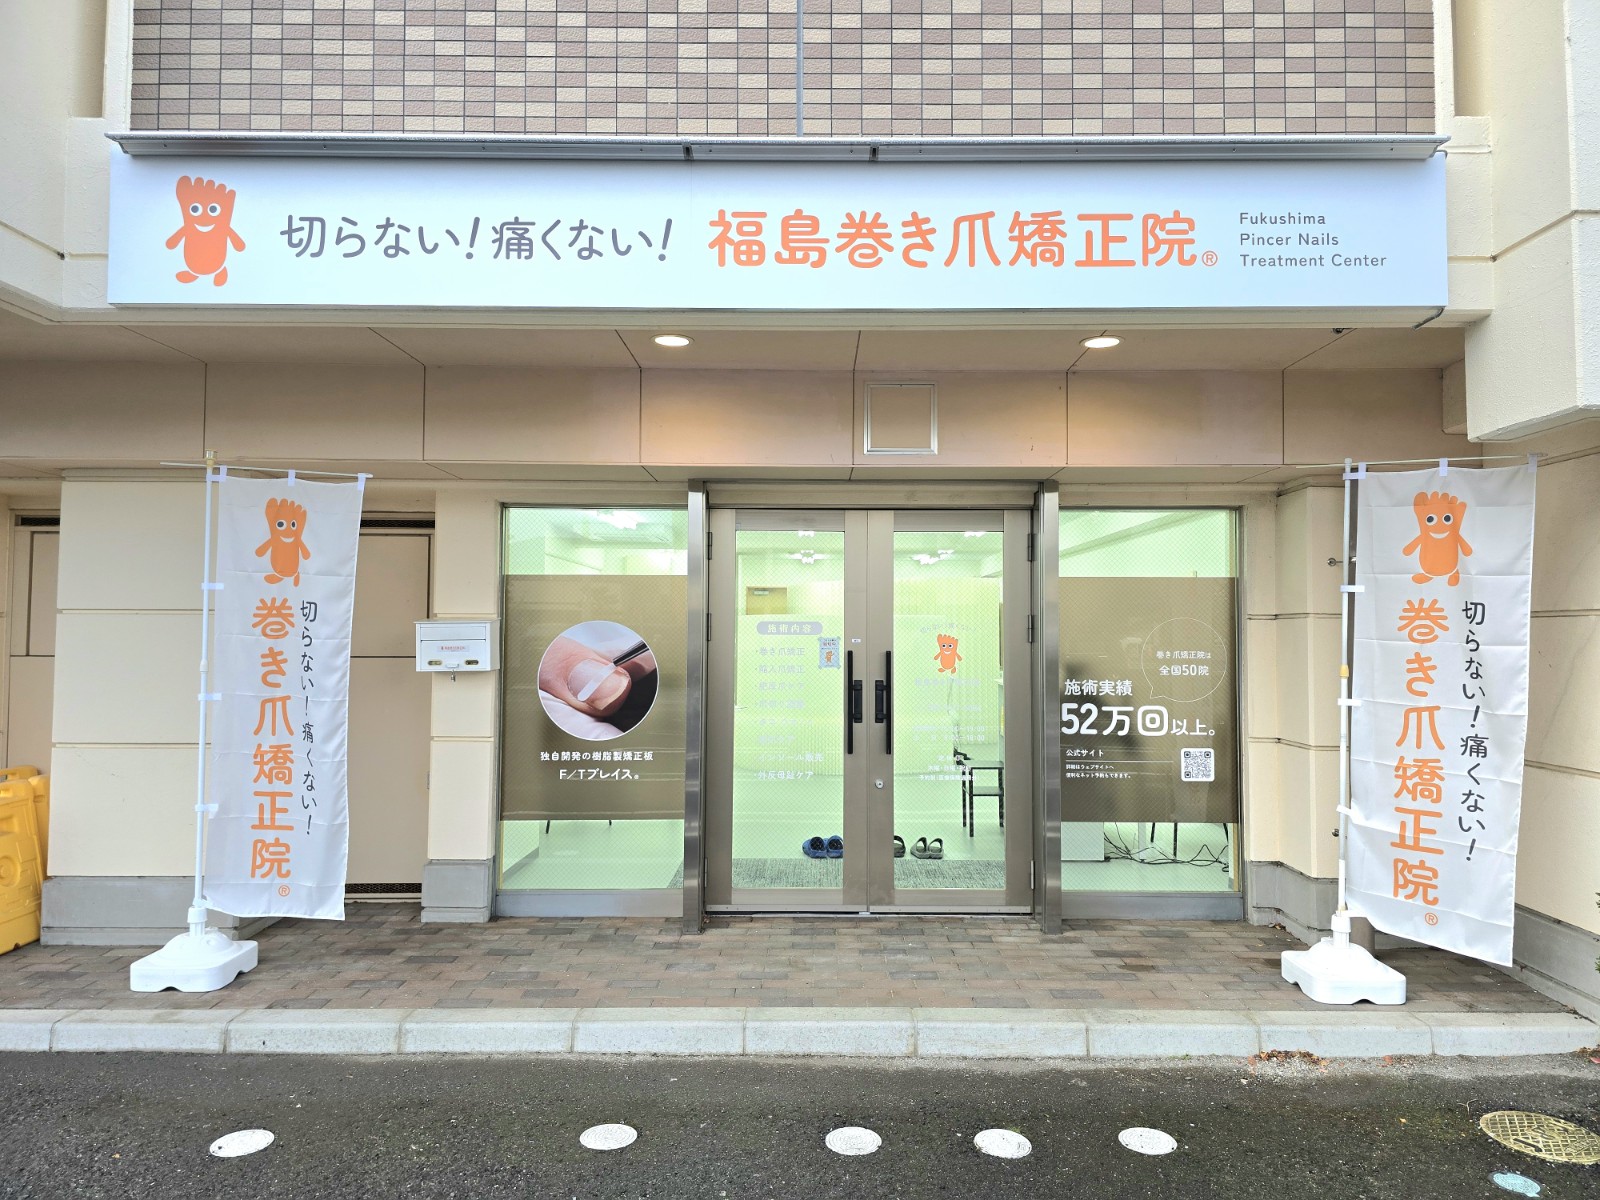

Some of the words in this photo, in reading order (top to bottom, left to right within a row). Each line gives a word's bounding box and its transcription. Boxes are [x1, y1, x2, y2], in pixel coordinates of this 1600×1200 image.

[1239, 212, 1326, 225] Fukushima
[1240, 233, 1292, 246] Pincer
[1298, 233, 1340, 246] Nails
[1240, 254, 1325, 267] Treatment
[1331, 254, 1387, 267] Center
[767, 623, 812, 634] 施術内容
[1156, 650, 1212, 659] 巻き爪矯正院は
[1159, 664, 1209, 676] 全国50院
[1064, 679, 1133, 696] 施術実績
[540, 751, 654, 761] 独自開発の樹脂製矯正板
[1065, 749, 1104, 757] 公式サイト
